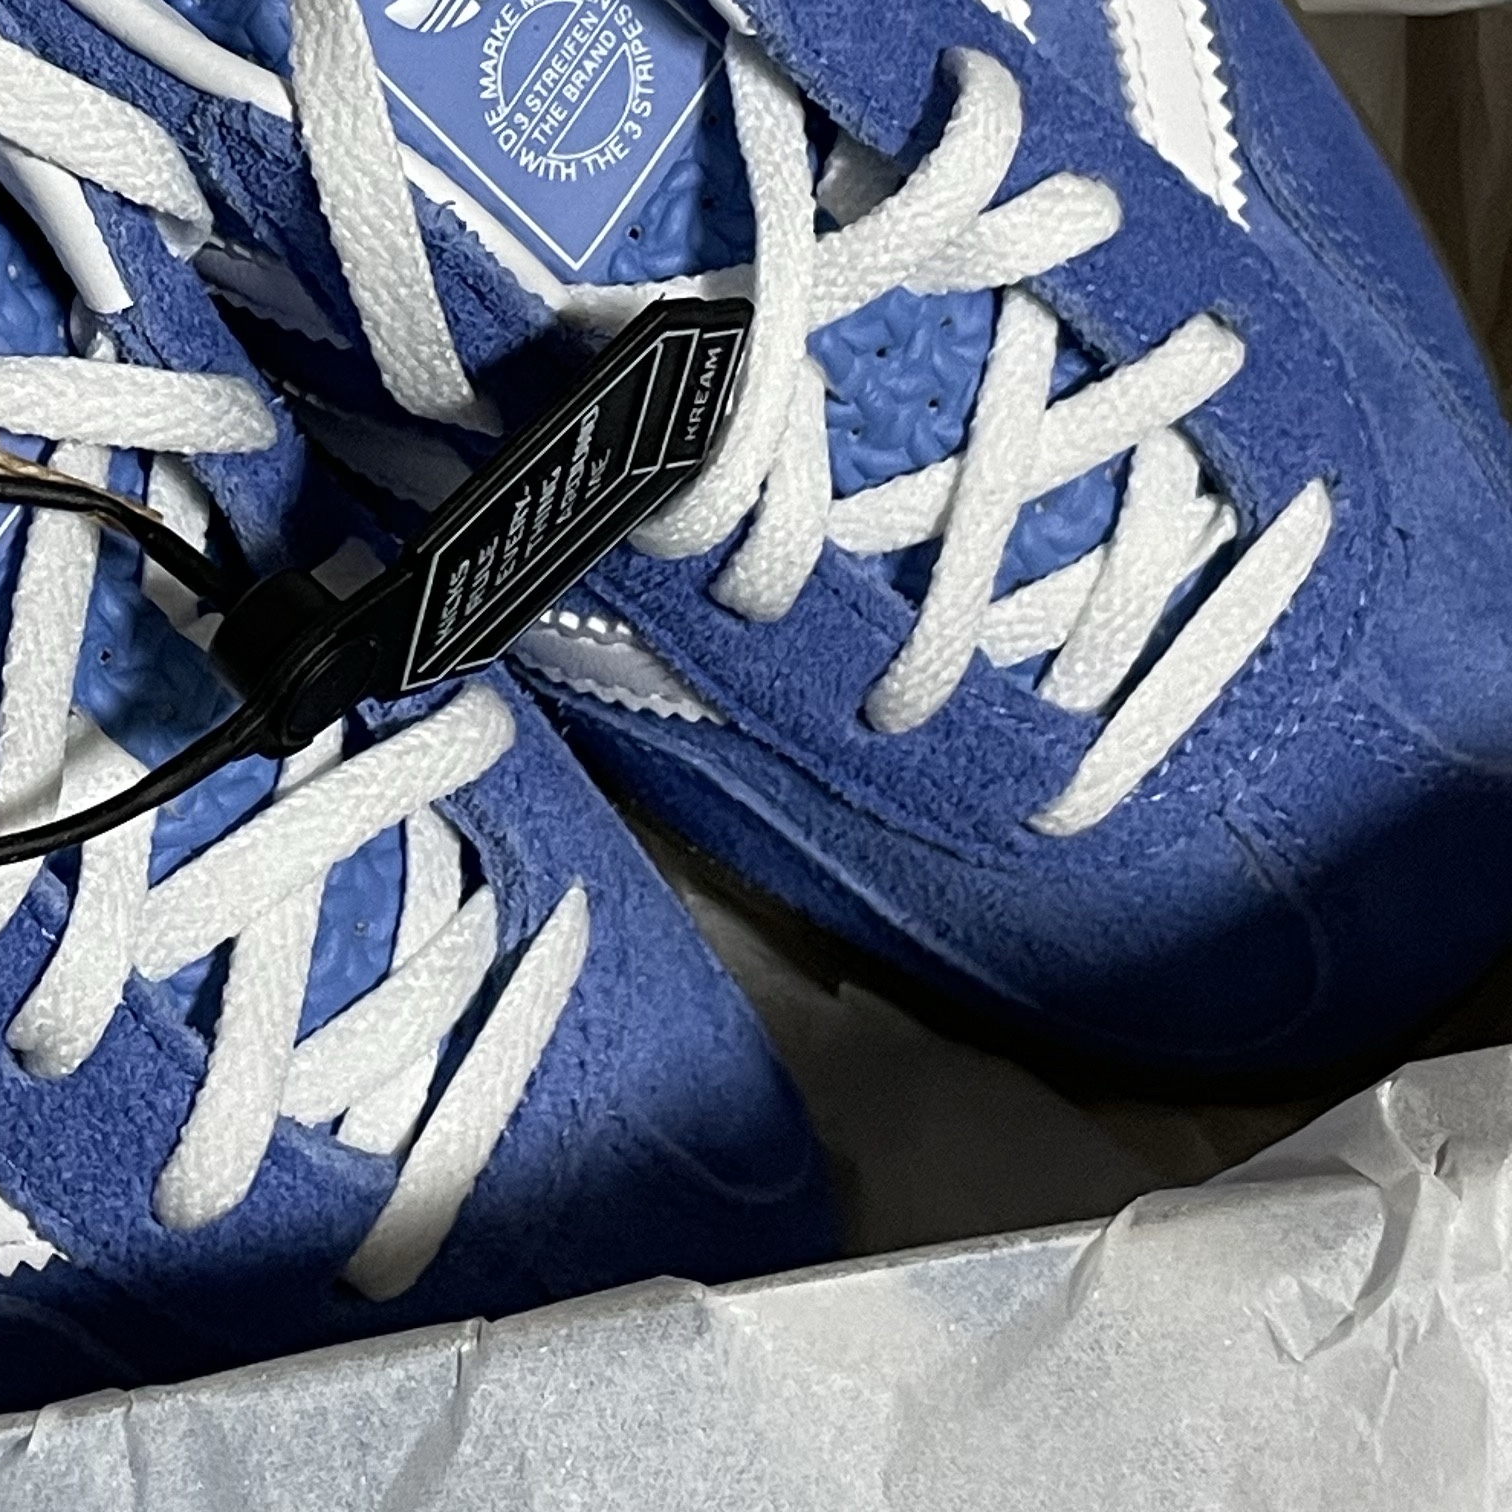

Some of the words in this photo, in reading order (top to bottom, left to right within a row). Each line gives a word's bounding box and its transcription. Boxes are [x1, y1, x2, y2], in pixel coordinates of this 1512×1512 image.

[479, 2, 520, 100] MARKE
[513, 112, 529, 130] 3
[525, 10, 599, 113] STREIFEN
[531, 100, 568, 144] THE
[562, 29, 617, 103] BRAND
[613, 3, 655, 118] STRIPES
[483, 105, 517, 152] DIE
[519, 146, 577, 182] WITH
[581, 135, 631, 177] THE
[624, 120, 642, 139] 3
[684, 347, 724, 441] KREAM
